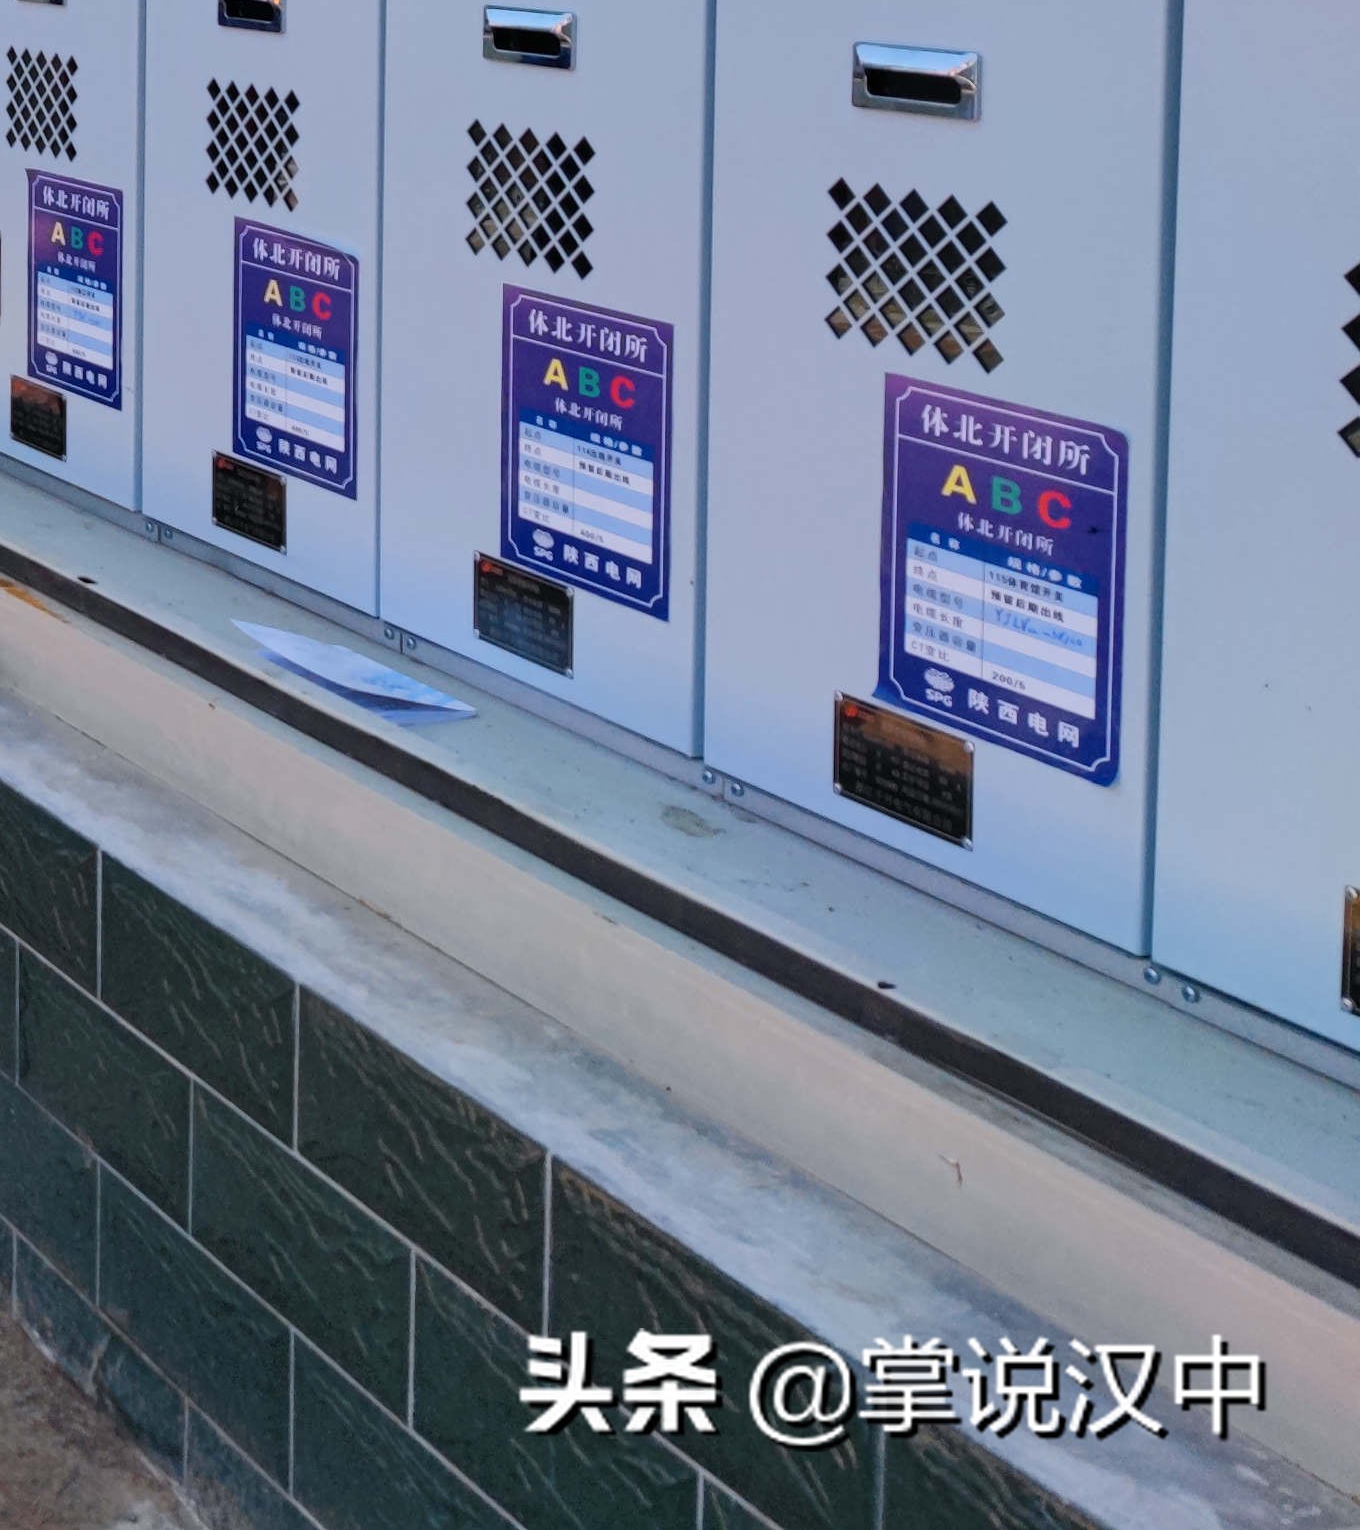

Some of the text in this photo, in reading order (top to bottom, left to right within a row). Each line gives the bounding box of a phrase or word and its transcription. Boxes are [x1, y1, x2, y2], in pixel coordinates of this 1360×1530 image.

[43, 185, 110, 220] 体北开闭所
[50, 221, 104, 256] A B C
[253, 237, 341, 281] 体北开闭所
[264, 279, 332, 321] A B C
[529, 309, 648, 364] 体北开闭所
[543, 358, 636, 408] A B C
[555, 397, 624, 431] 体北开闭所
[921, 403, 1091, 477] 体北开闭所
[941, 464, 1073, 529] A B C
[958, 512, 1055, 557] 体北开闭所
[563, 543, 642, 589] 陕西电网
[925, 687, 1080, 749] SPG 陕西电网
